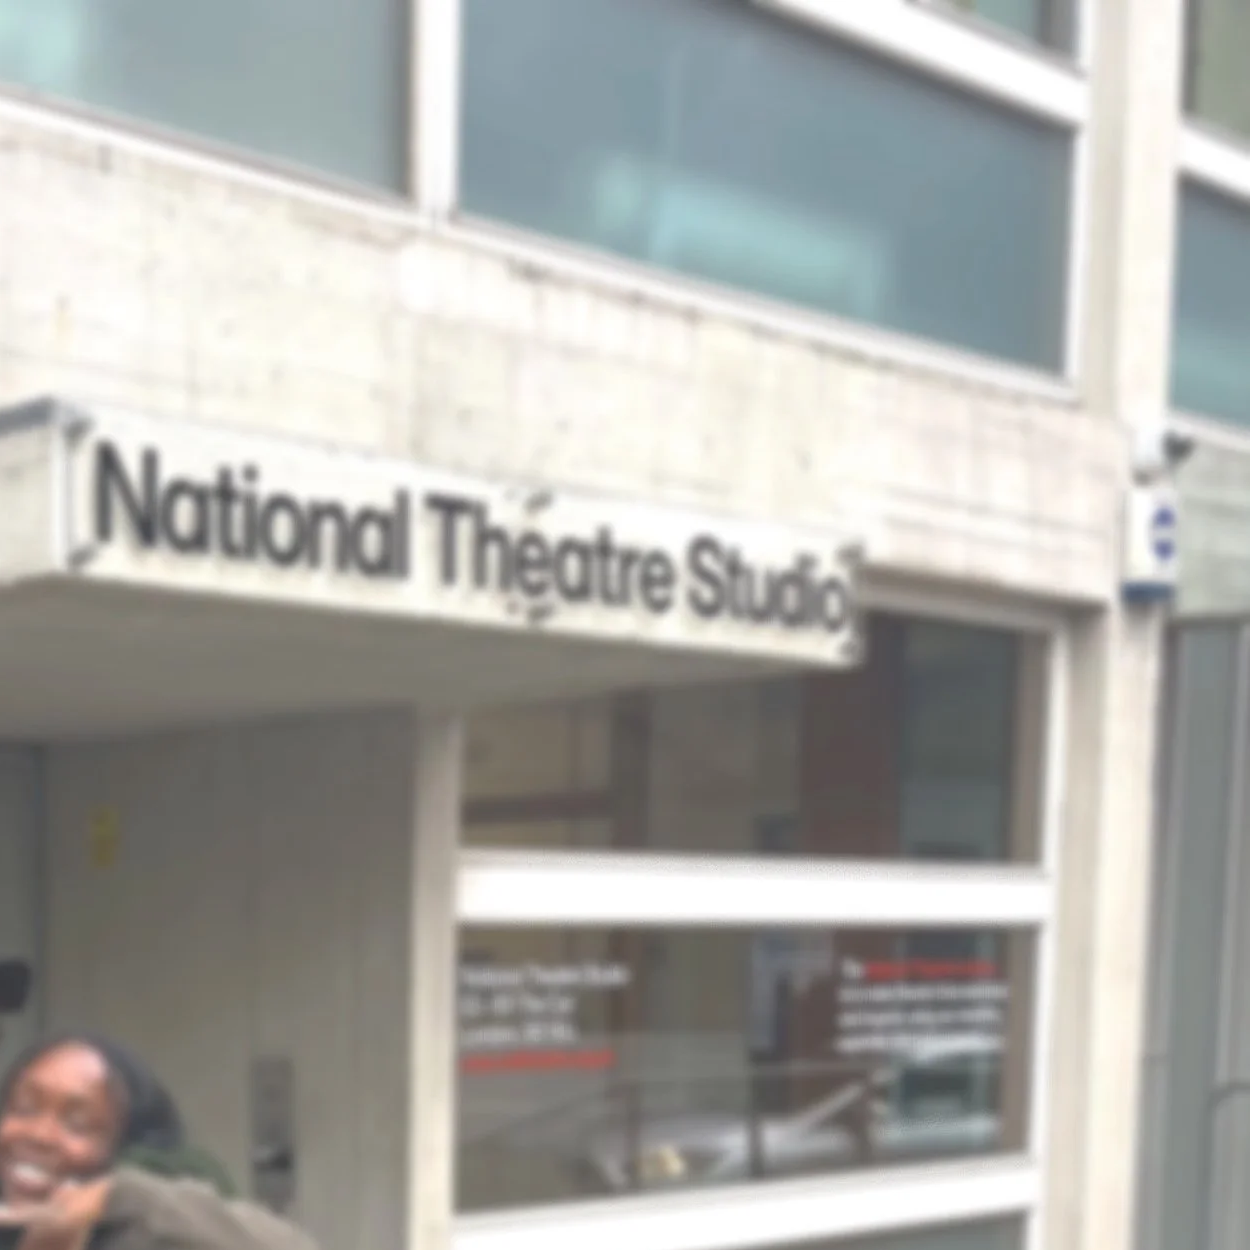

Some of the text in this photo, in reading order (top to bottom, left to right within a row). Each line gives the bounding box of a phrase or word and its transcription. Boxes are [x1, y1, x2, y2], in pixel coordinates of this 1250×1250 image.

[93, 440, 848, 634] National Theatre Studio
